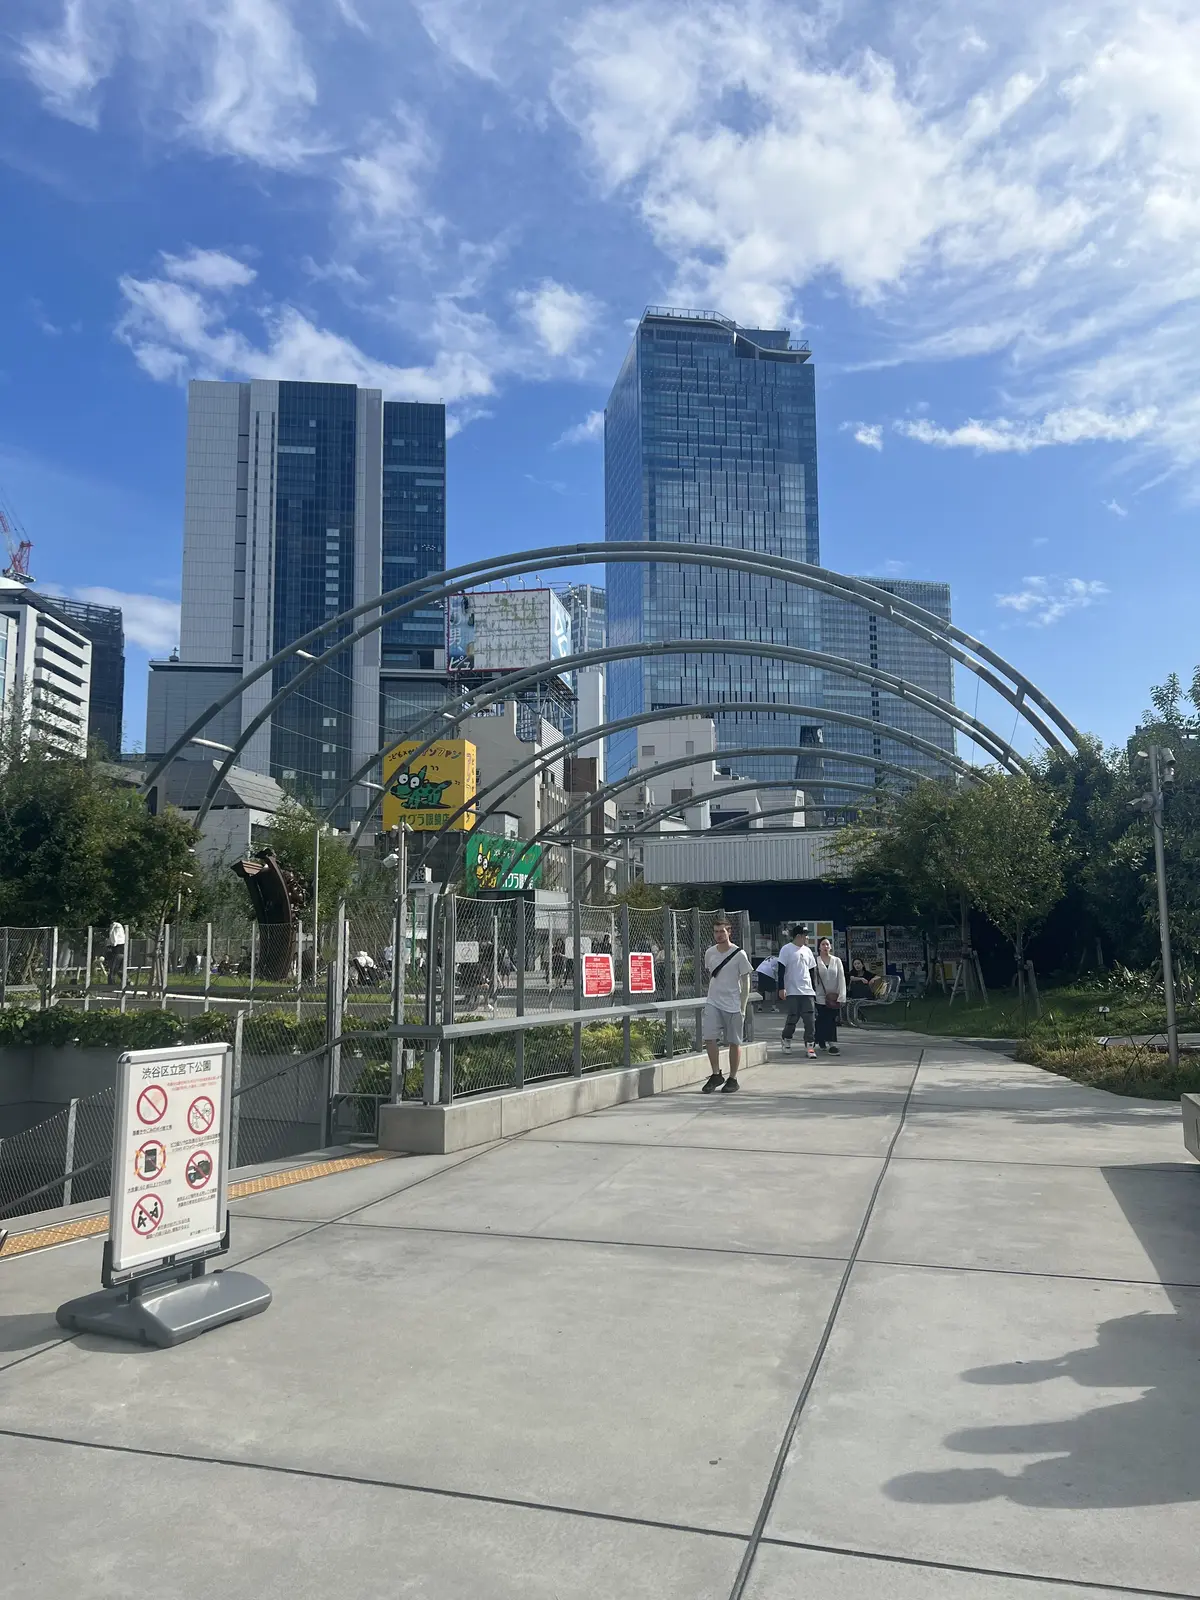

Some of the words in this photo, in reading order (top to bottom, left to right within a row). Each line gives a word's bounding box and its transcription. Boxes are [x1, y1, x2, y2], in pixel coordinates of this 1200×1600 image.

[142, 1060, 211, 1080] 渋谷区立宮下公園
